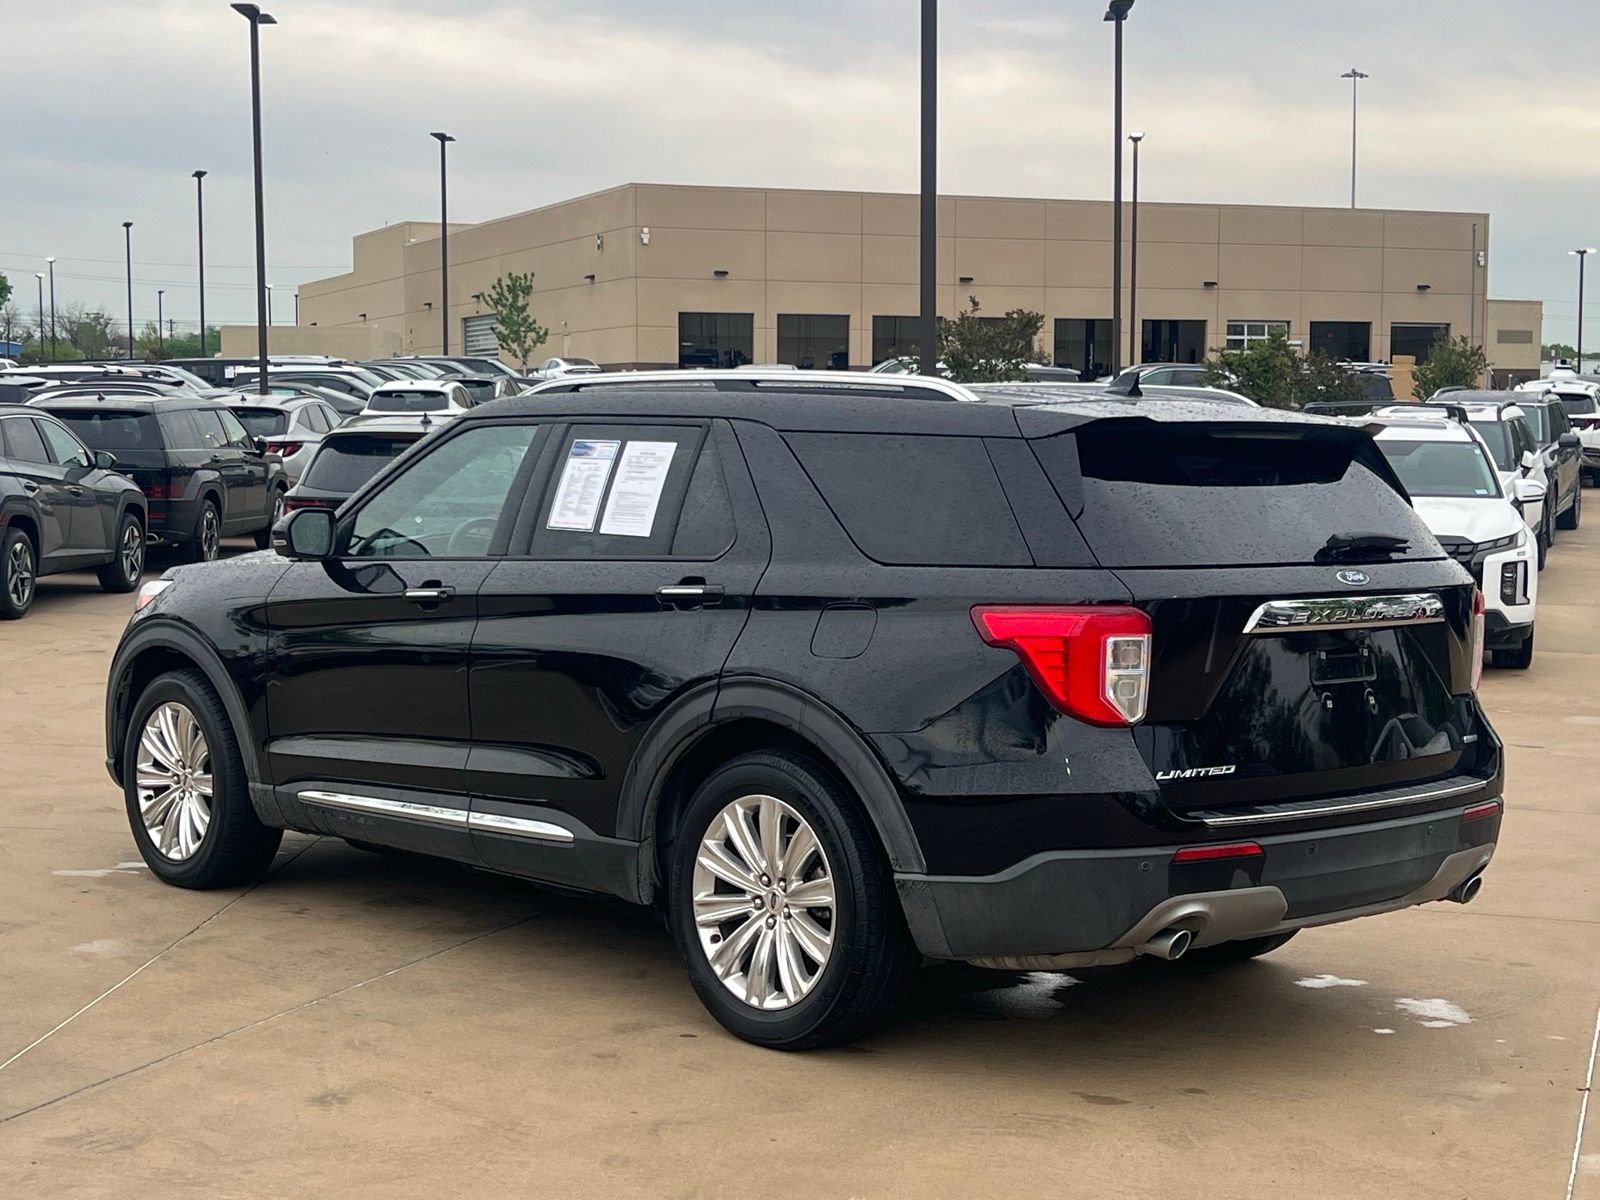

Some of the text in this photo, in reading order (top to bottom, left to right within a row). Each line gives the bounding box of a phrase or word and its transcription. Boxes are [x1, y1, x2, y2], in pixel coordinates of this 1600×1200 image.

[1345, 571, 1364, 581] Ford
[1289, 602, 1422, 623] EXPLORER
[1155, 765, 1236, 780] LIMITED
